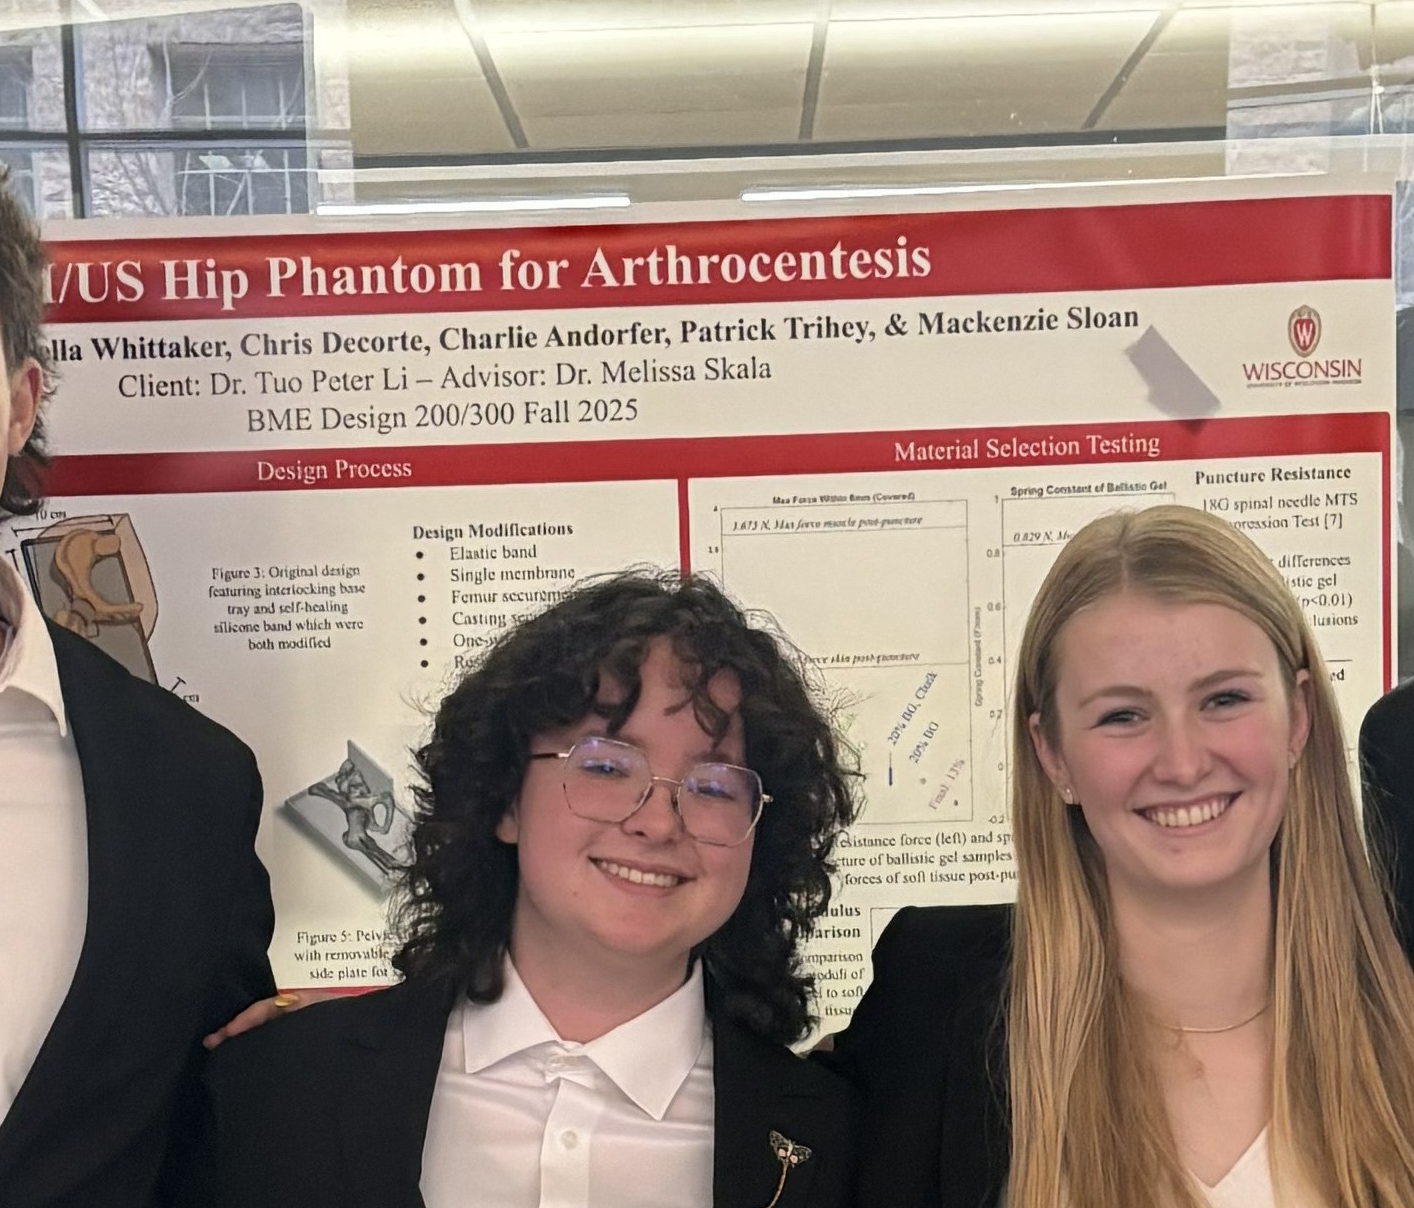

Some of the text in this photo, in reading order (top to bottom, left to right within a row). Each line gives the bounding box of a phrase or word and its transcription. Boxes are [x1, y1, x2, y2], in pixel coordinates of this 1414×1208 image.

[160, 257, 248, 310] Hip
[265, 255, 482, 297] Phantom
[499, 249, 569, 290] for
[581, 236, 931, 287] Arthrocentesis
[91, 335, 231, 361] Whittaker,
[241, 332, 312, 356] Chris
[323, 331, 430, 356] Decorte,
[440, 326, 537, 350] Charlie
[545, 322, 671, 348] Andorfer,
[681, 318, 776, 343] Patrick
[784, 316, 875, 343] Trihey,
[885, 314, 907, 336] &
[919, 308, 1058, 335] Mackenzie
[1067, 307, 1138, 329] Sloan
[1296, 322, 1313, 347] W
[119, 374, 199, 398] Client:
[211, 372, 246, 395] Dr.
[254, 371, 302, 394] Tuo
[312, 370, 374, 393] Peter
[383, 366, 407, 391] Li
[441, 364, 545, 389] Advisor:
[556, 363, 591, 385] Dr.
[601, 358, 696, 384] Melissa
[705, 356, 771, 381] Skala
[1242, 359, 1362, 381] WISCONSIN
[248, 398, 637, 435] BME Design 200/300 Fall 2025
[895, 433, 1160, 461] Material Selection Testing
[257, 459, 411, 484] Design Process
[1196, 464, 1351, 485] Puncture Resistance
[1234, 496, 1272, 513] spinal
[1278, 493, 1320, 508] needle
[1326, 492, 1358, 506] MTS
[1292, 512, 1342, 529] Test [7]
[413, 521, 573, 543] Design Modifications
[1277, 553, 1351, 568] differences
[1317, 573, 1336, 589] gel
[452, 610, 507, 629] Casting
[901, 831, 993, 848] force (left) and
[869, 850, 1012, 867] of ballistic gel samples
[845, 871, 965, 884] forces of soft tissue
